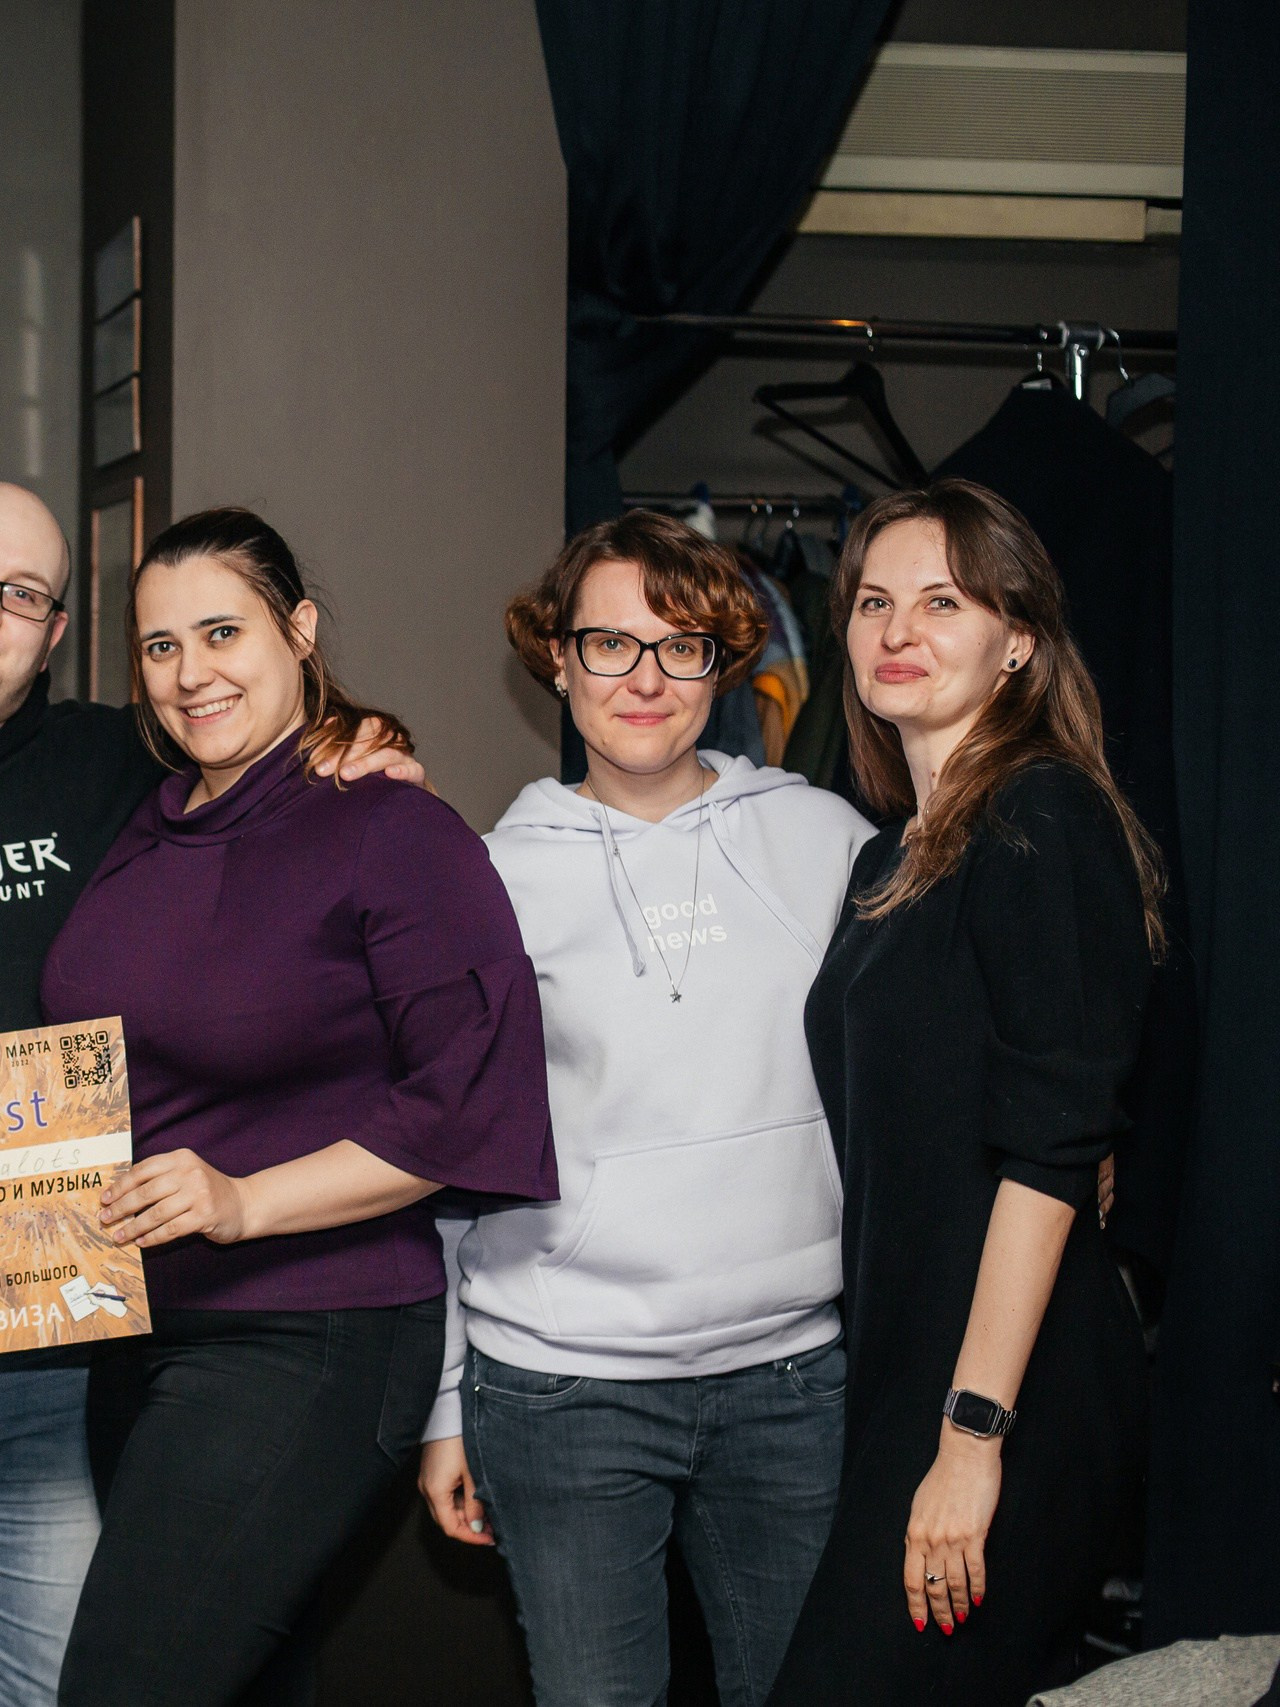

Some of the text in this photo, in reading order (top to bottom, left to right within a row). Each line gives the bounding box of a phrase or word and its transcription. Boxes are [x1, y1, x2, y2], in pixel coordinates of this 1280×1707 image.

[642, 893, 718, 930] good
[647, 925, 728, 953] news
[5, 1040, 52, 1059] МАРТА
[13, 1183, 24, 1200] И
[31, 1171, 103, 1198] МУЗЫКА
[6, 1264, 79, 1287] БОЛЬШОГО
